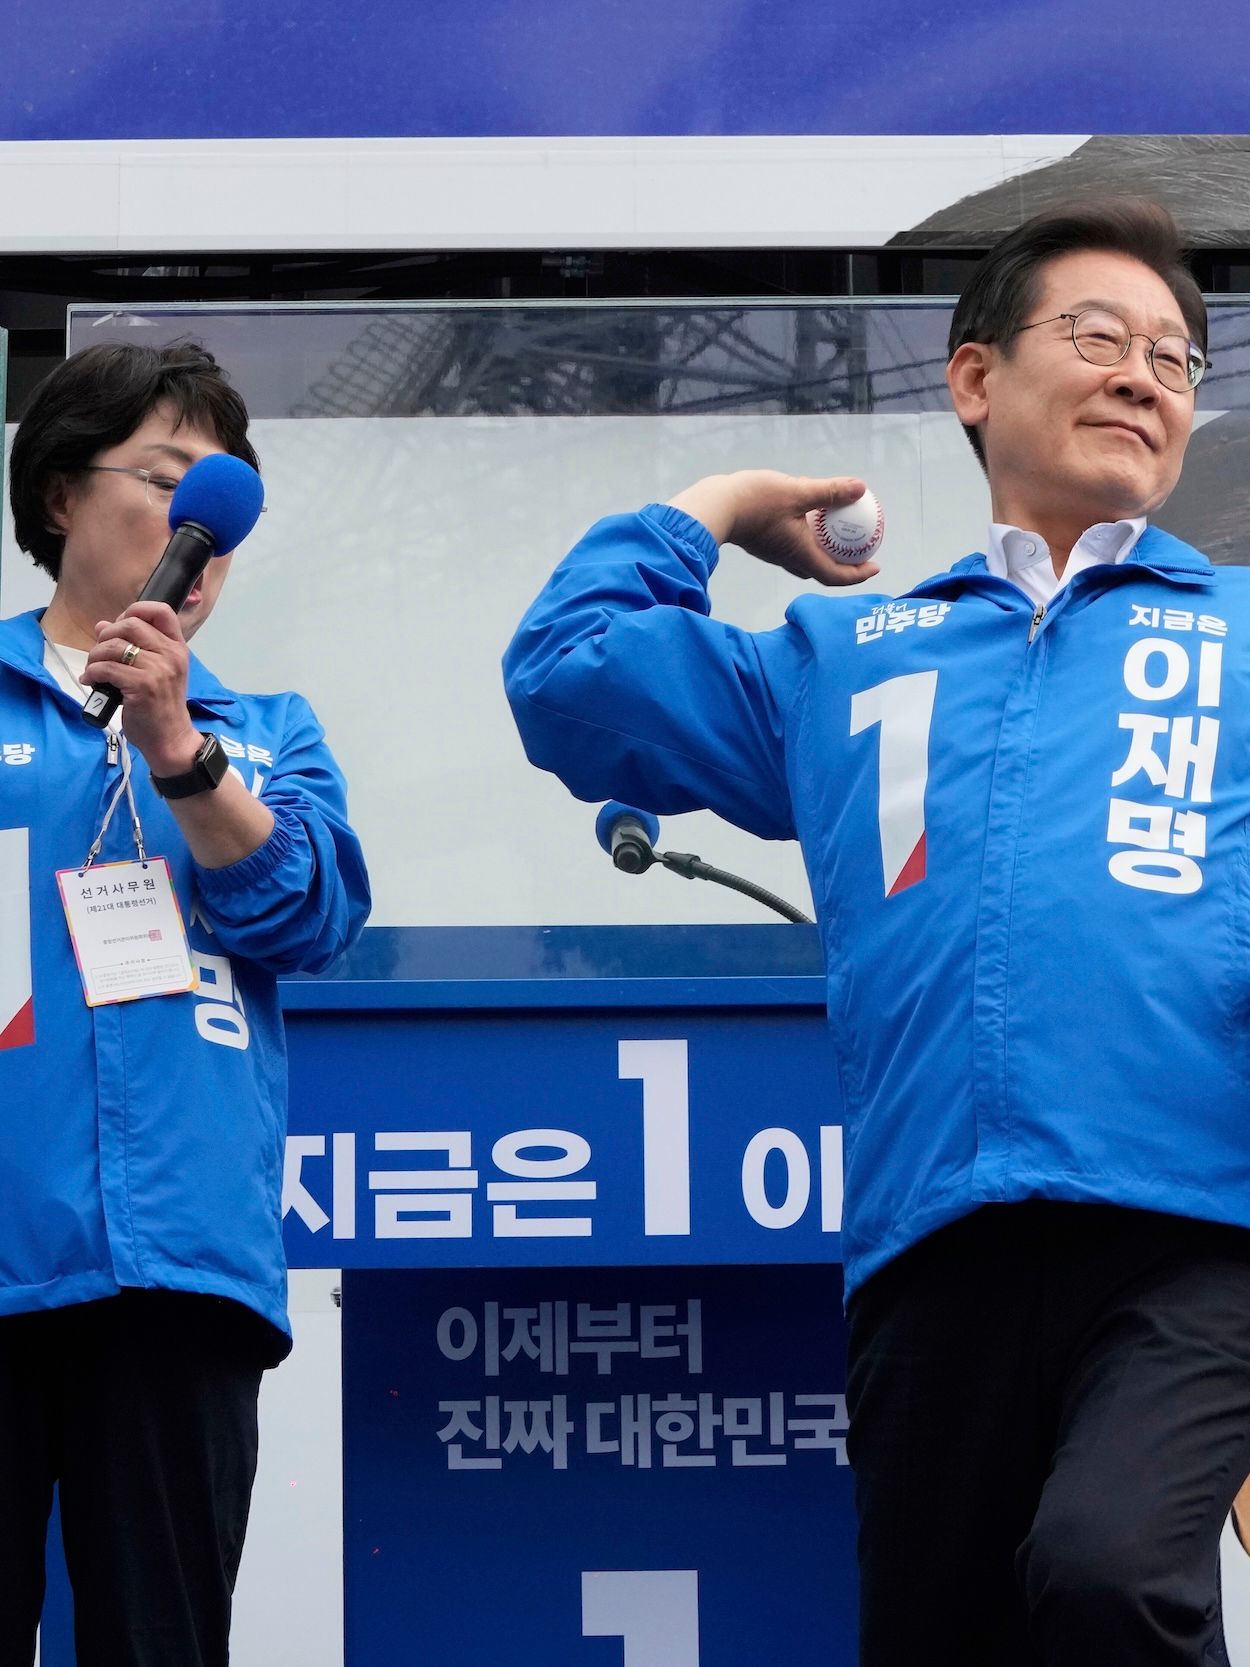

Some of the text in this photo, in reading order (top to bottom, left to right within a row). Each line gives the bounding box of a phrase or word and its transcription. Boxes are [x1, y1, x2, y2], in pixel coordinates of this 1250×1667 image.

[856, 603, 951, 645] 민주당
[1128, 604, 1228, 637] 지금은
[220, 734, 274, 768] 금은
[1107, 637, 1223, 895] 이재명
[850, 669, 939, 898] 1
[80, 878, 156, 900] 선거사무원
[86, 896, 157, 915] (제21대 대통령선거)
[281, 1128, 597, 1240] 지금은
[618, 1039, 691, 1236] 1
[436, 1299, 702, 1376] 이제부터
[436, 1391, 850, 1471] 진짜 대한민국
